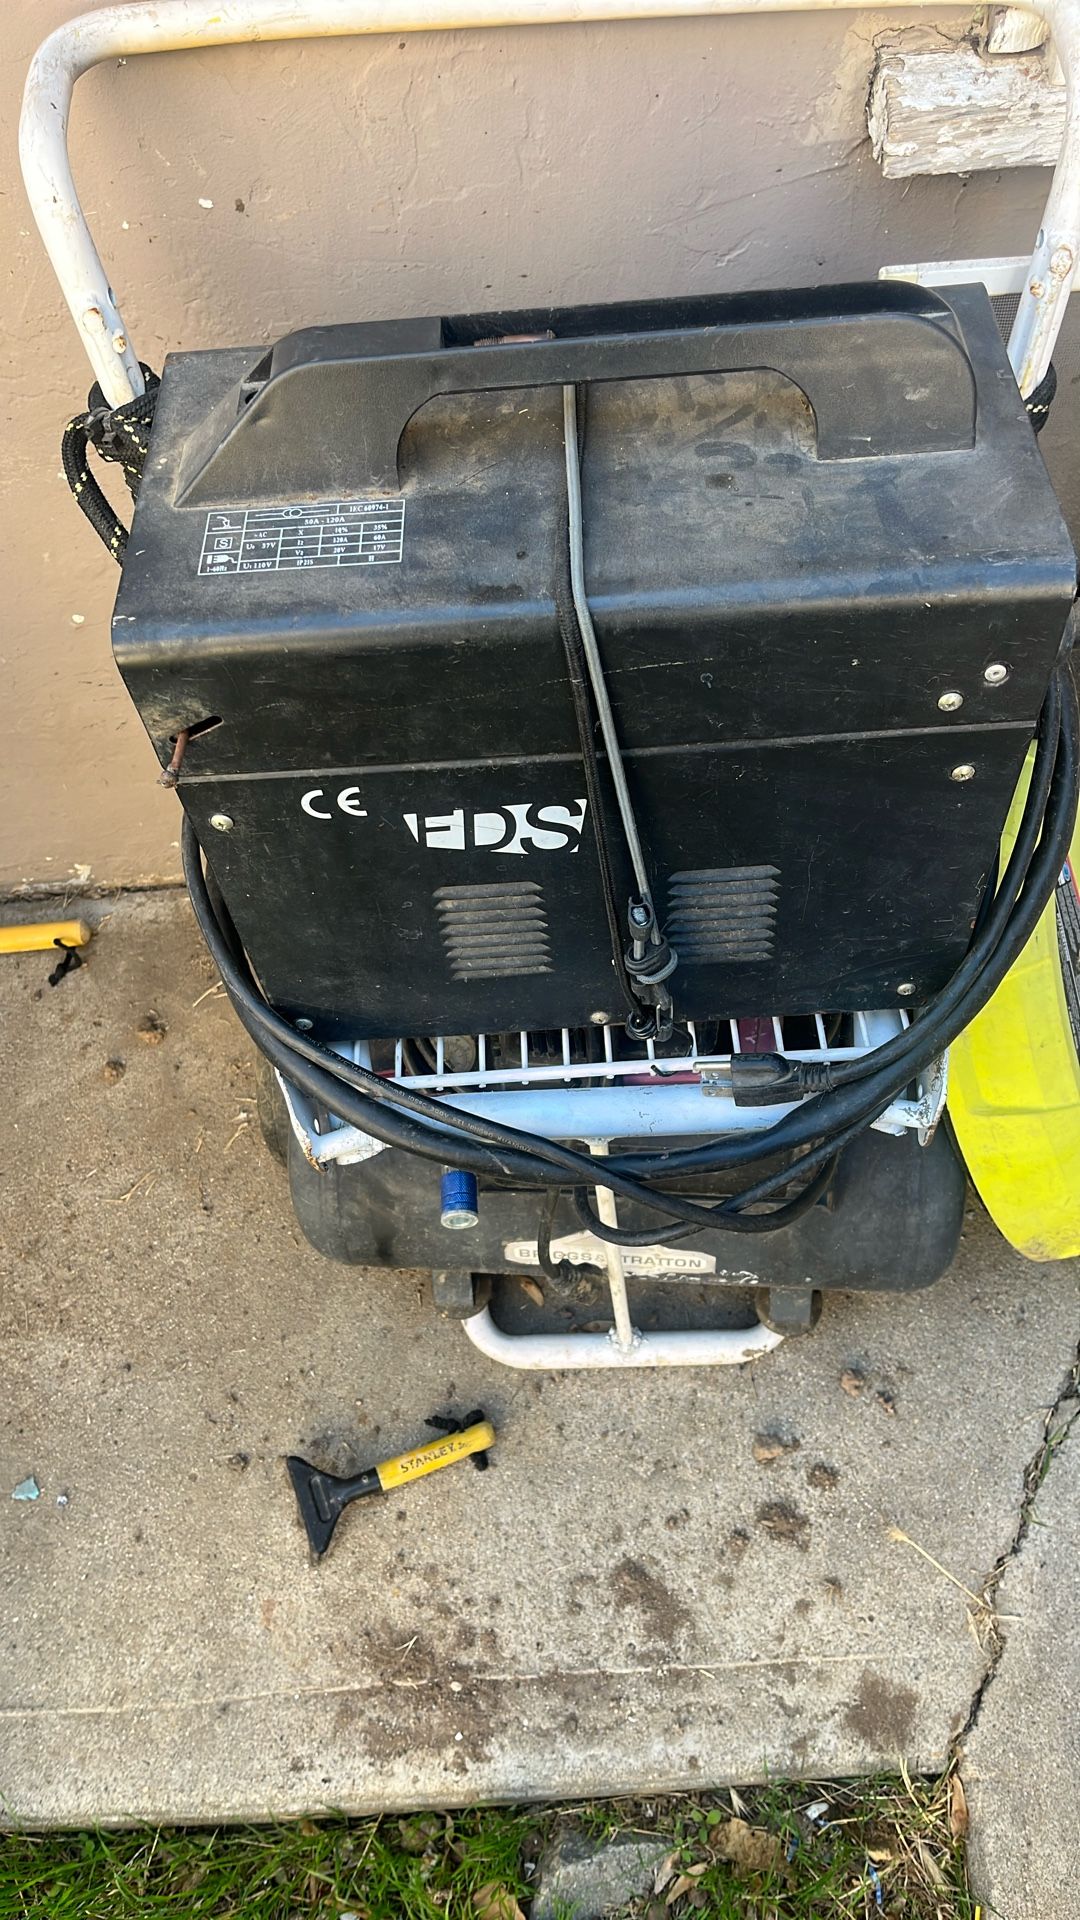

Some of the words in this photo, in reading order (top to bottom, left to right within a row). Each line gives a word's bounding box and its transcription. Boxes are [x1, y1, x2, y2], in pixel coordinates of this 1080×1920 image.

[219, 539, 229, 548] S
[253, 561, 272, 569] 110V
[301, 786, 368, 820] CE
[400, 1442, 455, 1473] STANLEY
